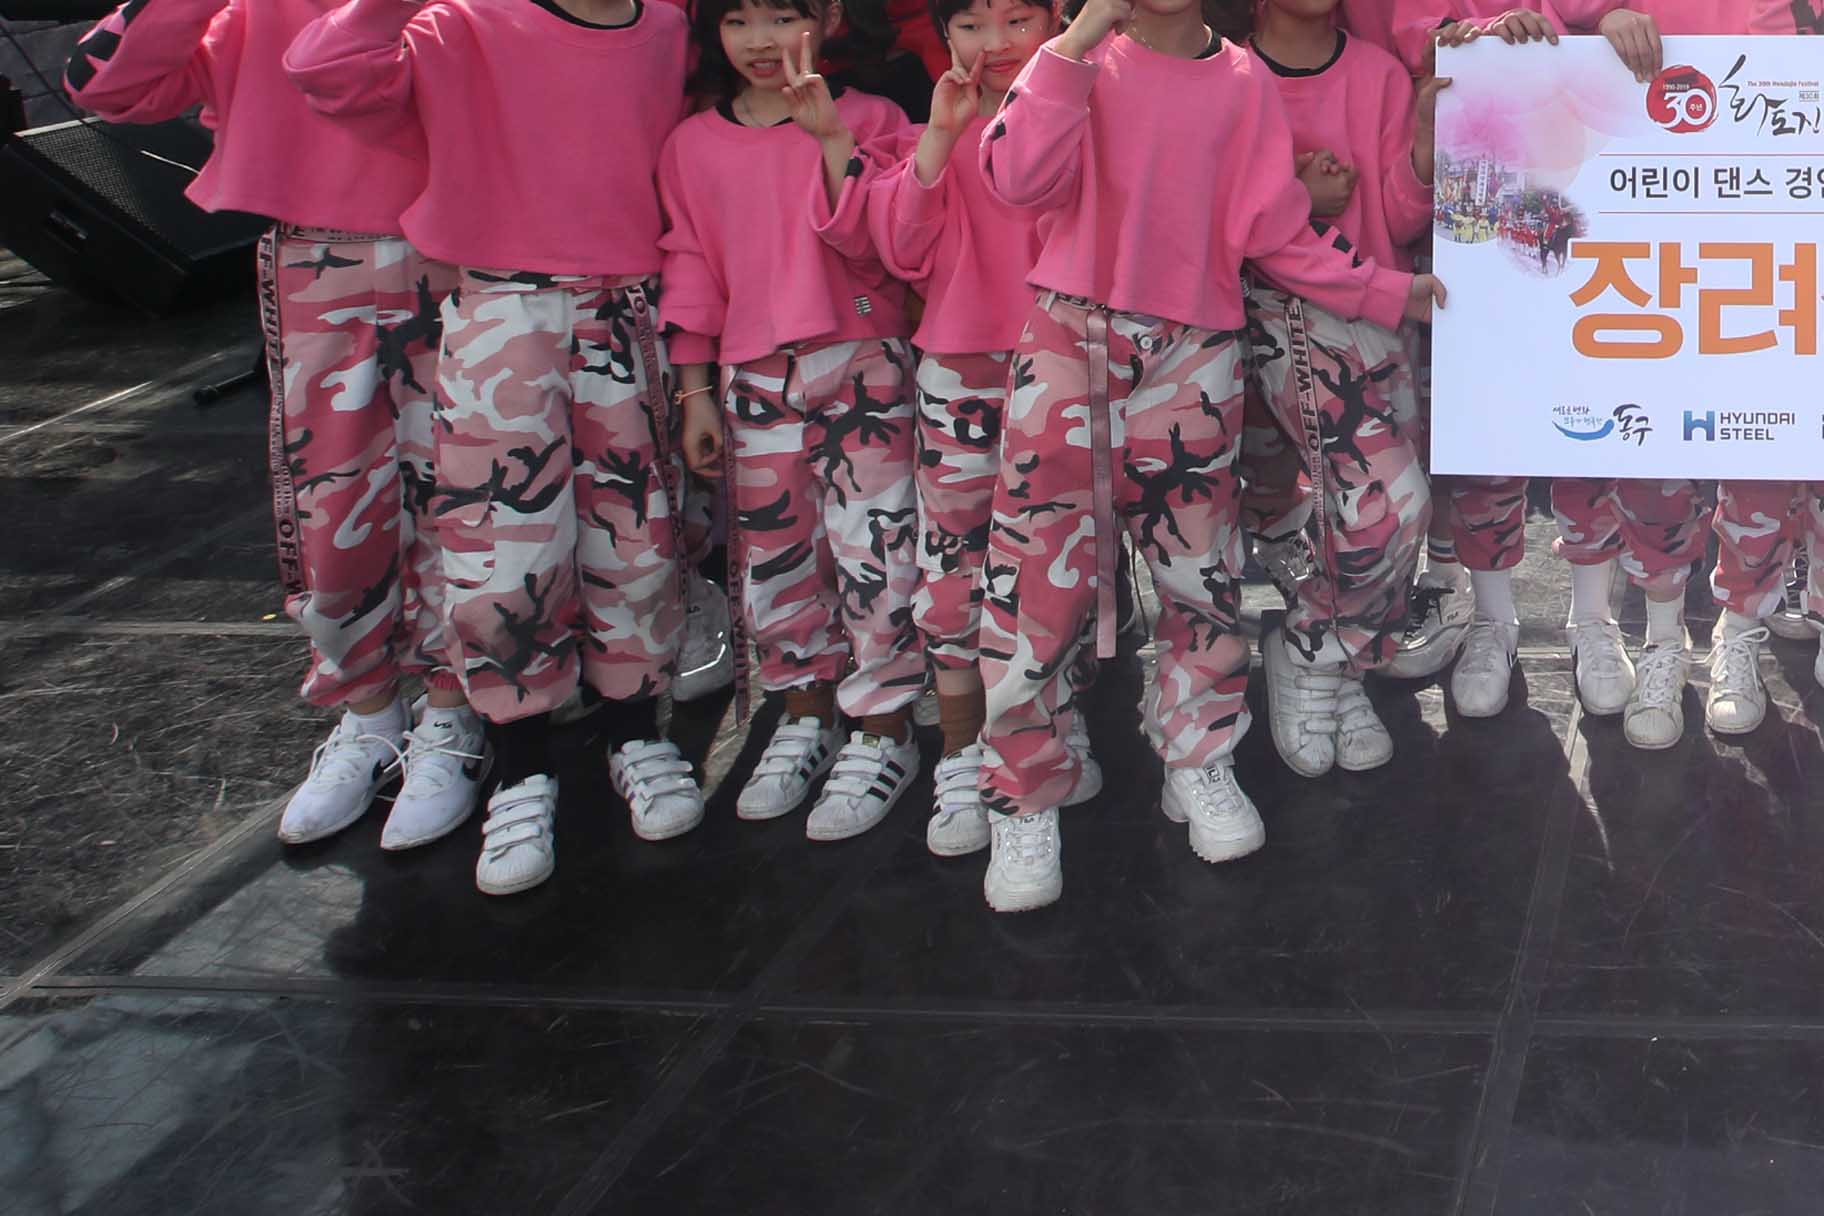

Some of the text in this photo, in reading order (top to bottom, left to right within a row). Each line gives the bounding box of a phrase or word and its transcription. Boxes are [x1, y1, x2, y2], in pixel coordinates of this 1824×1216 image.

[1654, 88, 1714, 128] 30
[1610, 166, 1699, 199] 어린이
[1713, 166, 1773, 199] 댄스
[259, 237, 281, 368] FF-WHITE
[1289, 304, 1319, 451] OFF-WHITE
[1613, 403, 1653, 446] 동구
[1720, 412, 1795, 425] HYUNDAI
[1720, 428, 1775, 441] STEEL
[278, 520, 304, 594] OFF-W
